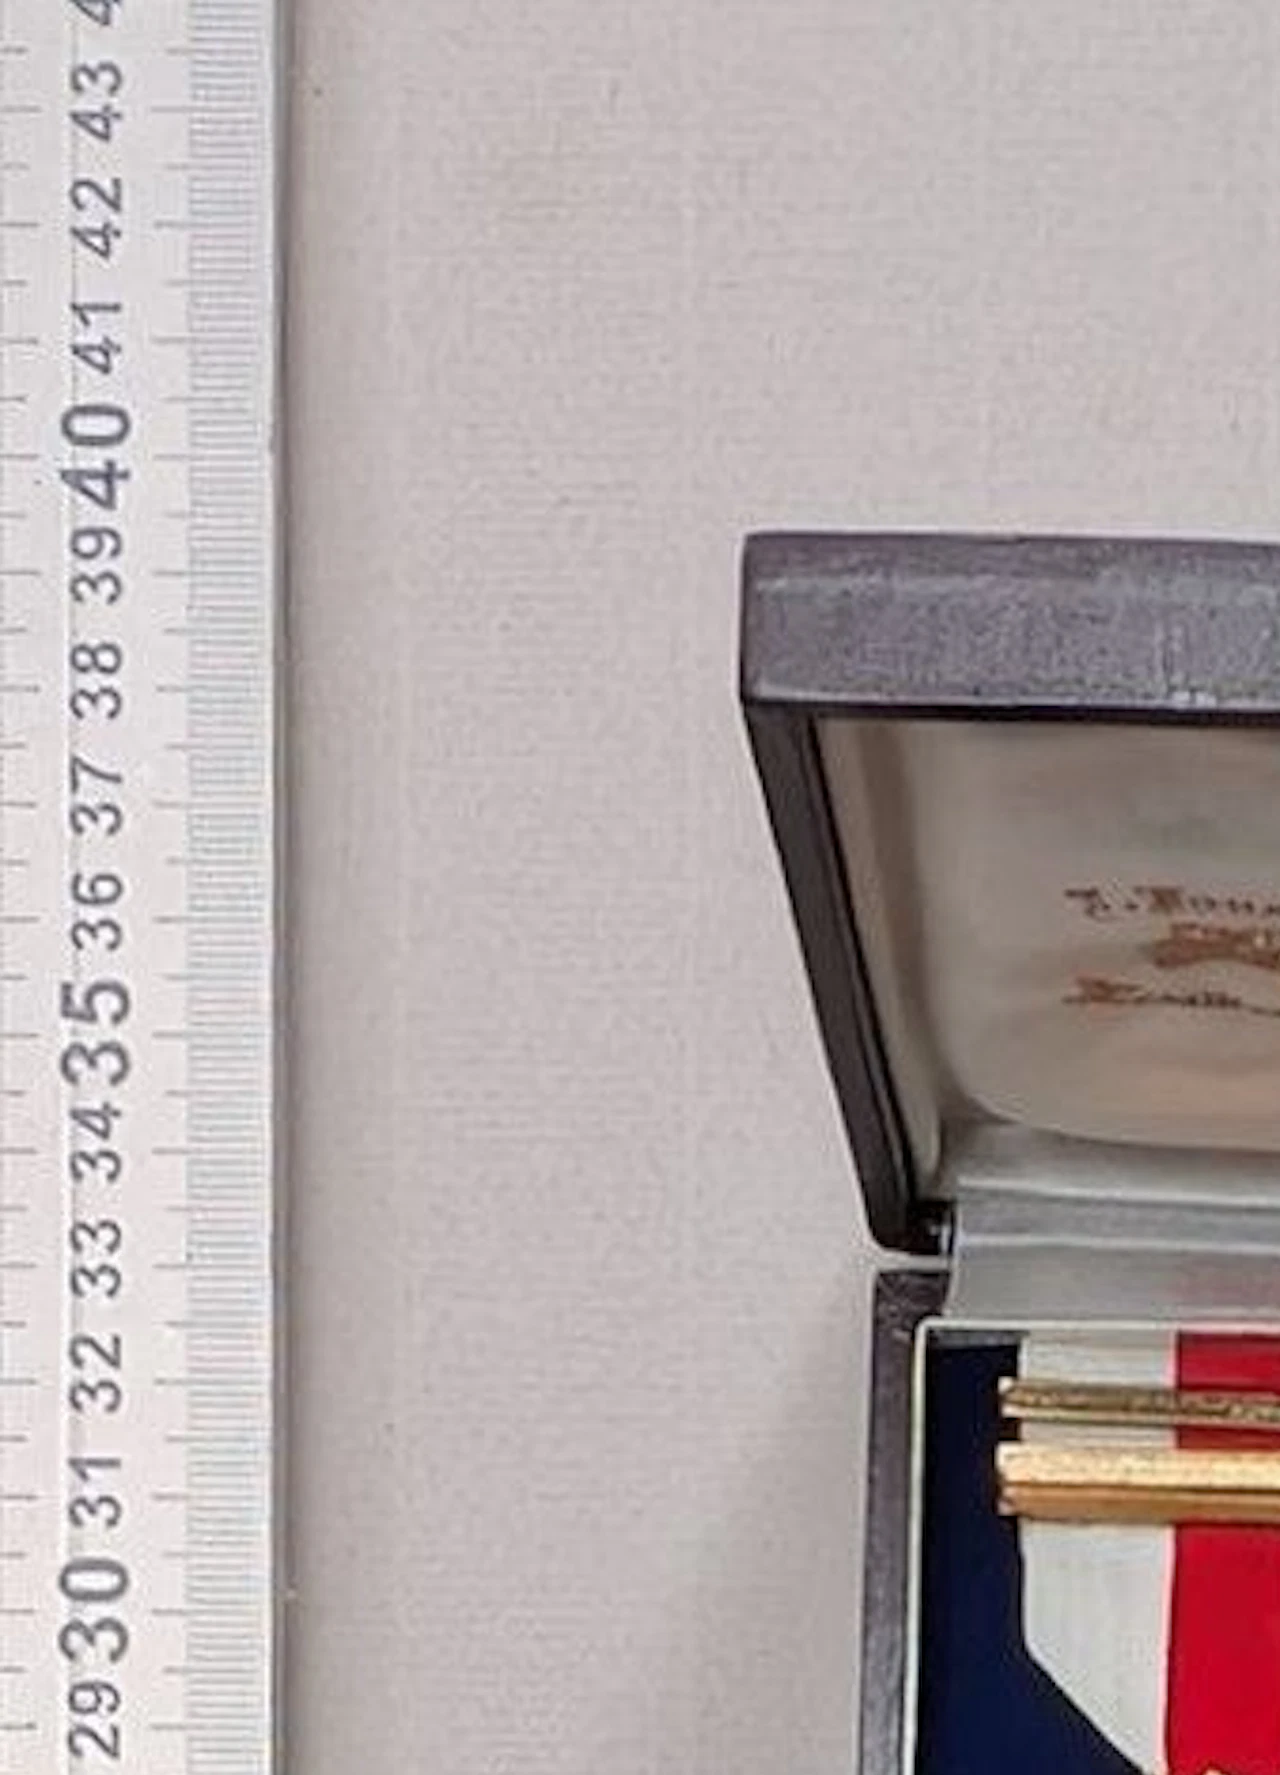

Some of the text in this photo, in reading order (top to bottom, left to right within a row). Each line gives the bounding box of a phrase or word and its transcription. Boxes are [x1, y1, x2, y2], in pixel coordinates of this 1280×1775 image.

[69, 62, 122, 142] 43
[68, 178, 122, 260] 42
[70, 302, 122, 375] 41
[58, 404, 131, 511] 40
[69, 527, 122, 605] 39
[69, 642, 122, 720] 38
[69, 754, 123, 836] 37
[70, 872, 124, 951] 36
[60, 981, 131, 1086] 35
[69, 1102, 121, 1183] 34
[69, 1220, 121, 1298] 33
[68, 1334, 121, 1413] 32
[68, 1458, 121, 1528] 31
[58, 1558, 129, 1663] 30
[67, 1681, 121, 1759] 29
